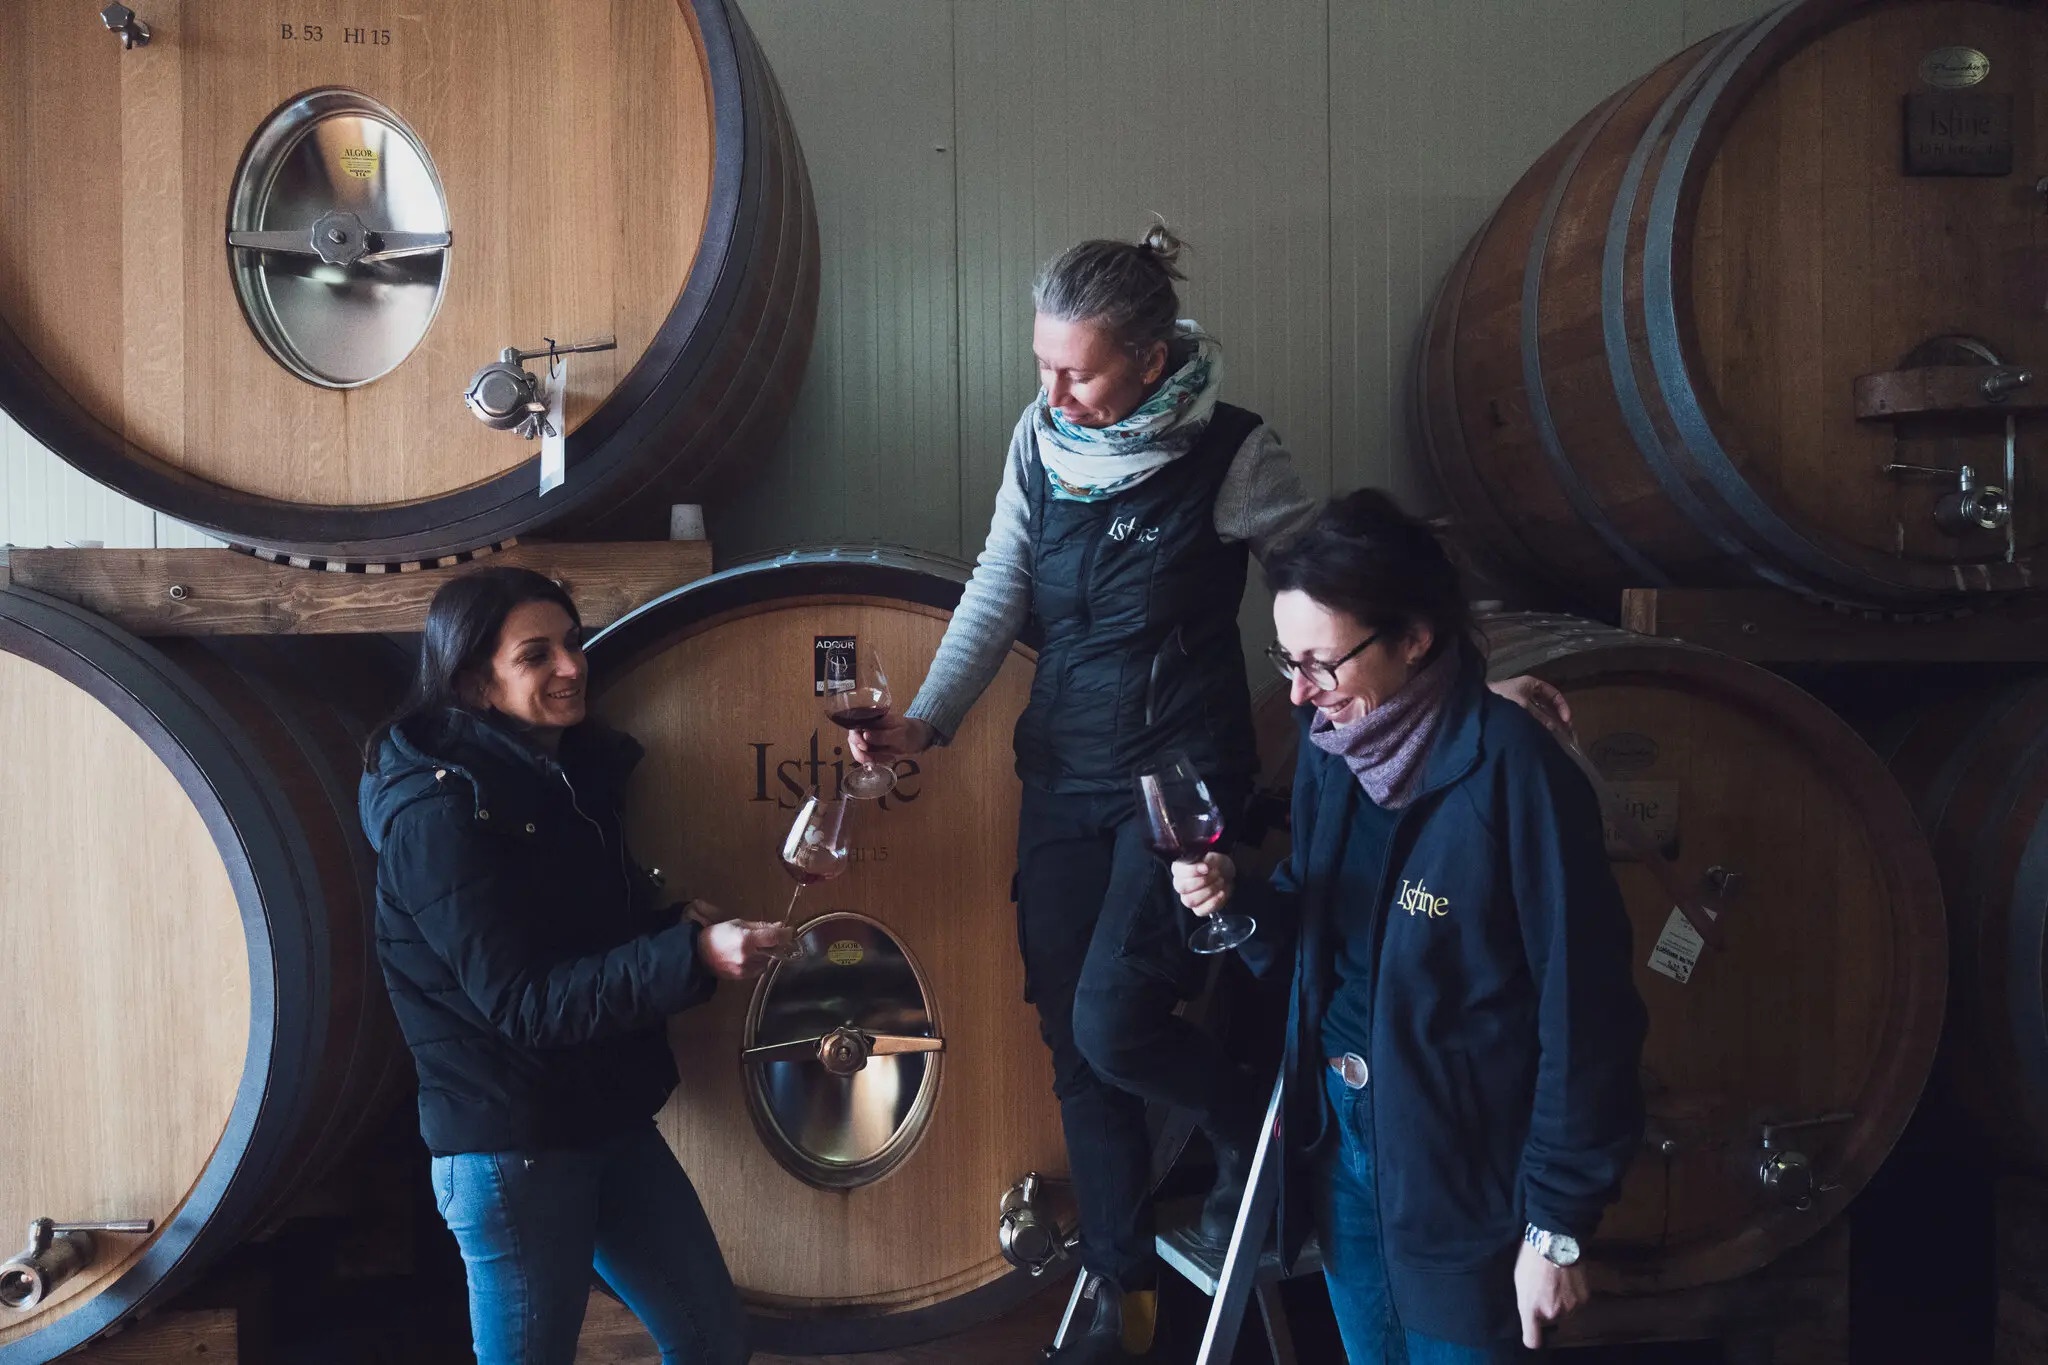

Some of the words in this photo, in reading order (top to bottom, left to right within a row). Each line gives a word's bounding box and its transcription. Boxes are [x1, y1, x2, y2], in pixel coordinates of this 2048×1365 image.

[281, 23, 298, 40] B.
[303, 25, 323, 42] 53
[371, 29, 391, 46] 15
[345, 149, 372, 158] ALGOR
[1107, 516, 1159, 542] Iste
[1397, 878, 1449, 918] Istine
